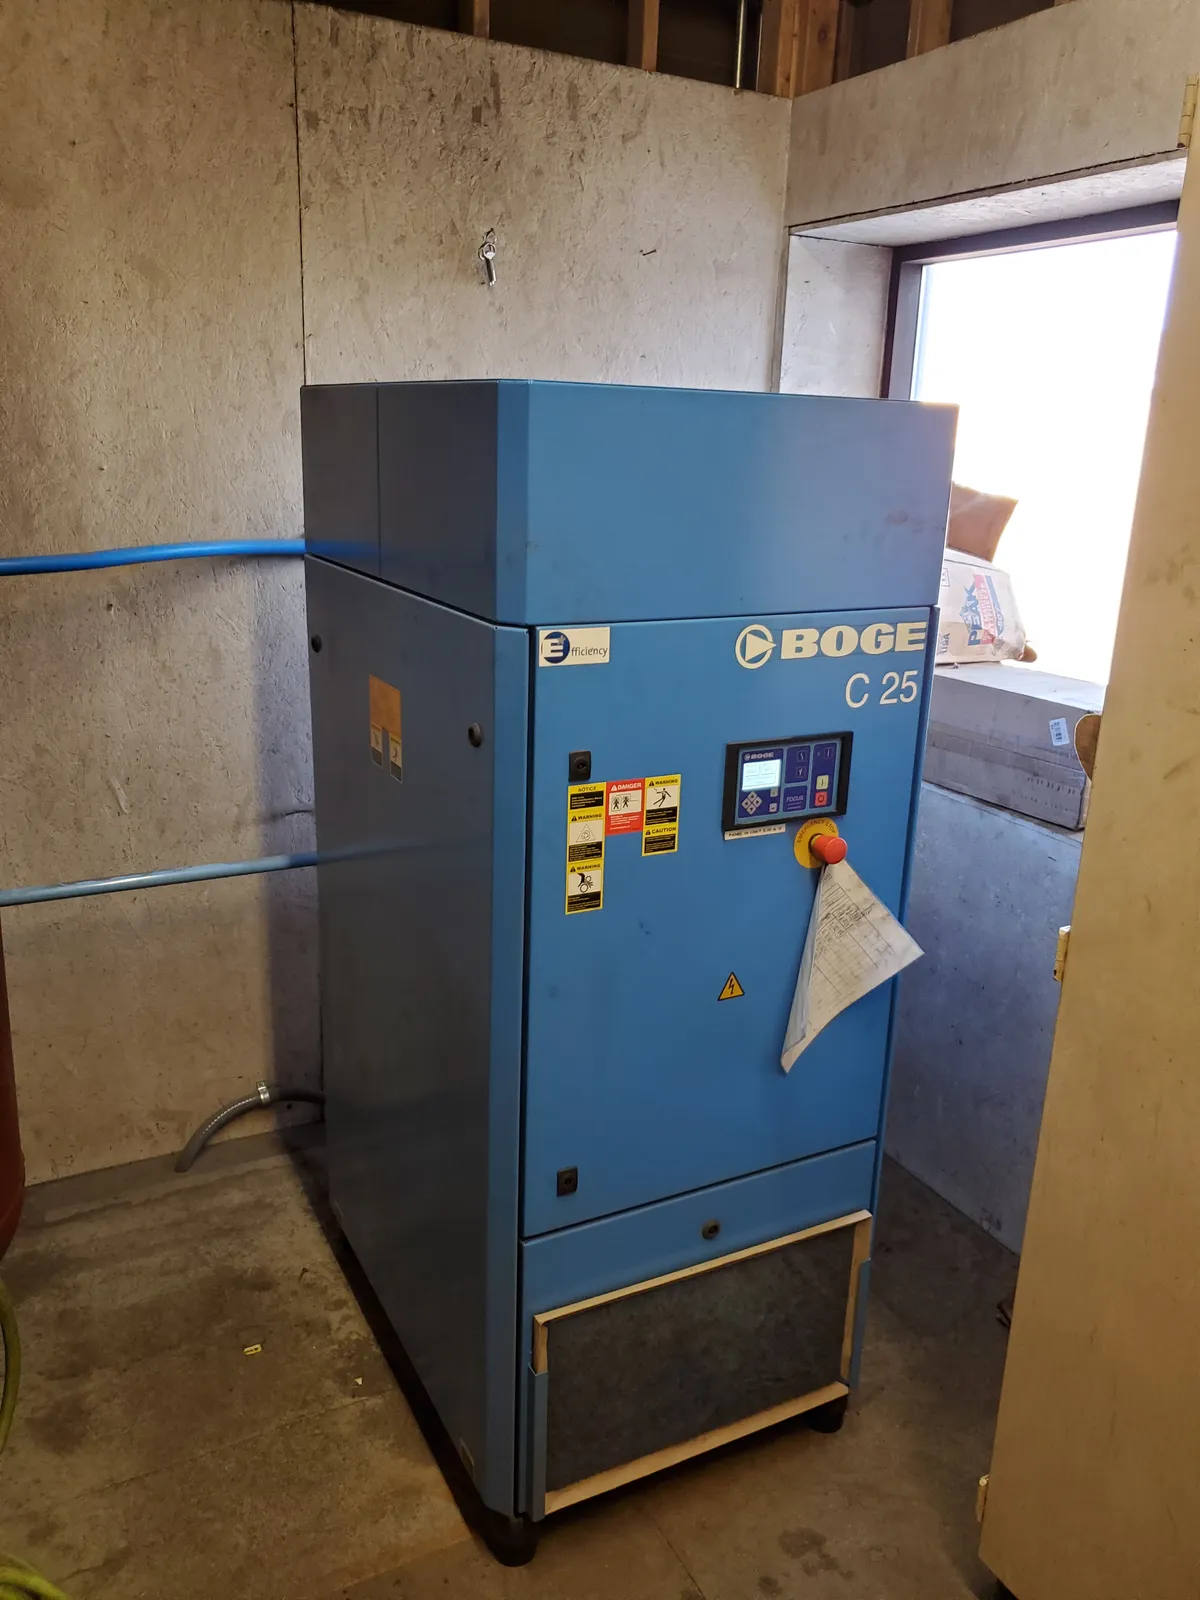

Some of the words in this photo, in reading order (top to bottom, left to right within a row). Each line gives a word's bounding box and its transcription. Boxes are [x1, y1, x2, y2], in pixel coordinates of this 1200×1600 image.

[964, 580, 982, 646] PEAK
[780, 622, 927, 660] BOGE
[845, 672, 870, 709] C
[879, 670, 918, 705] 25
[617, 782, 642, 790] DANGER
[786, 794, 804, 802] FOCUS
[796, 820, 825, 843] EMERGENCY
[825, 820, 836, 834] STOP
